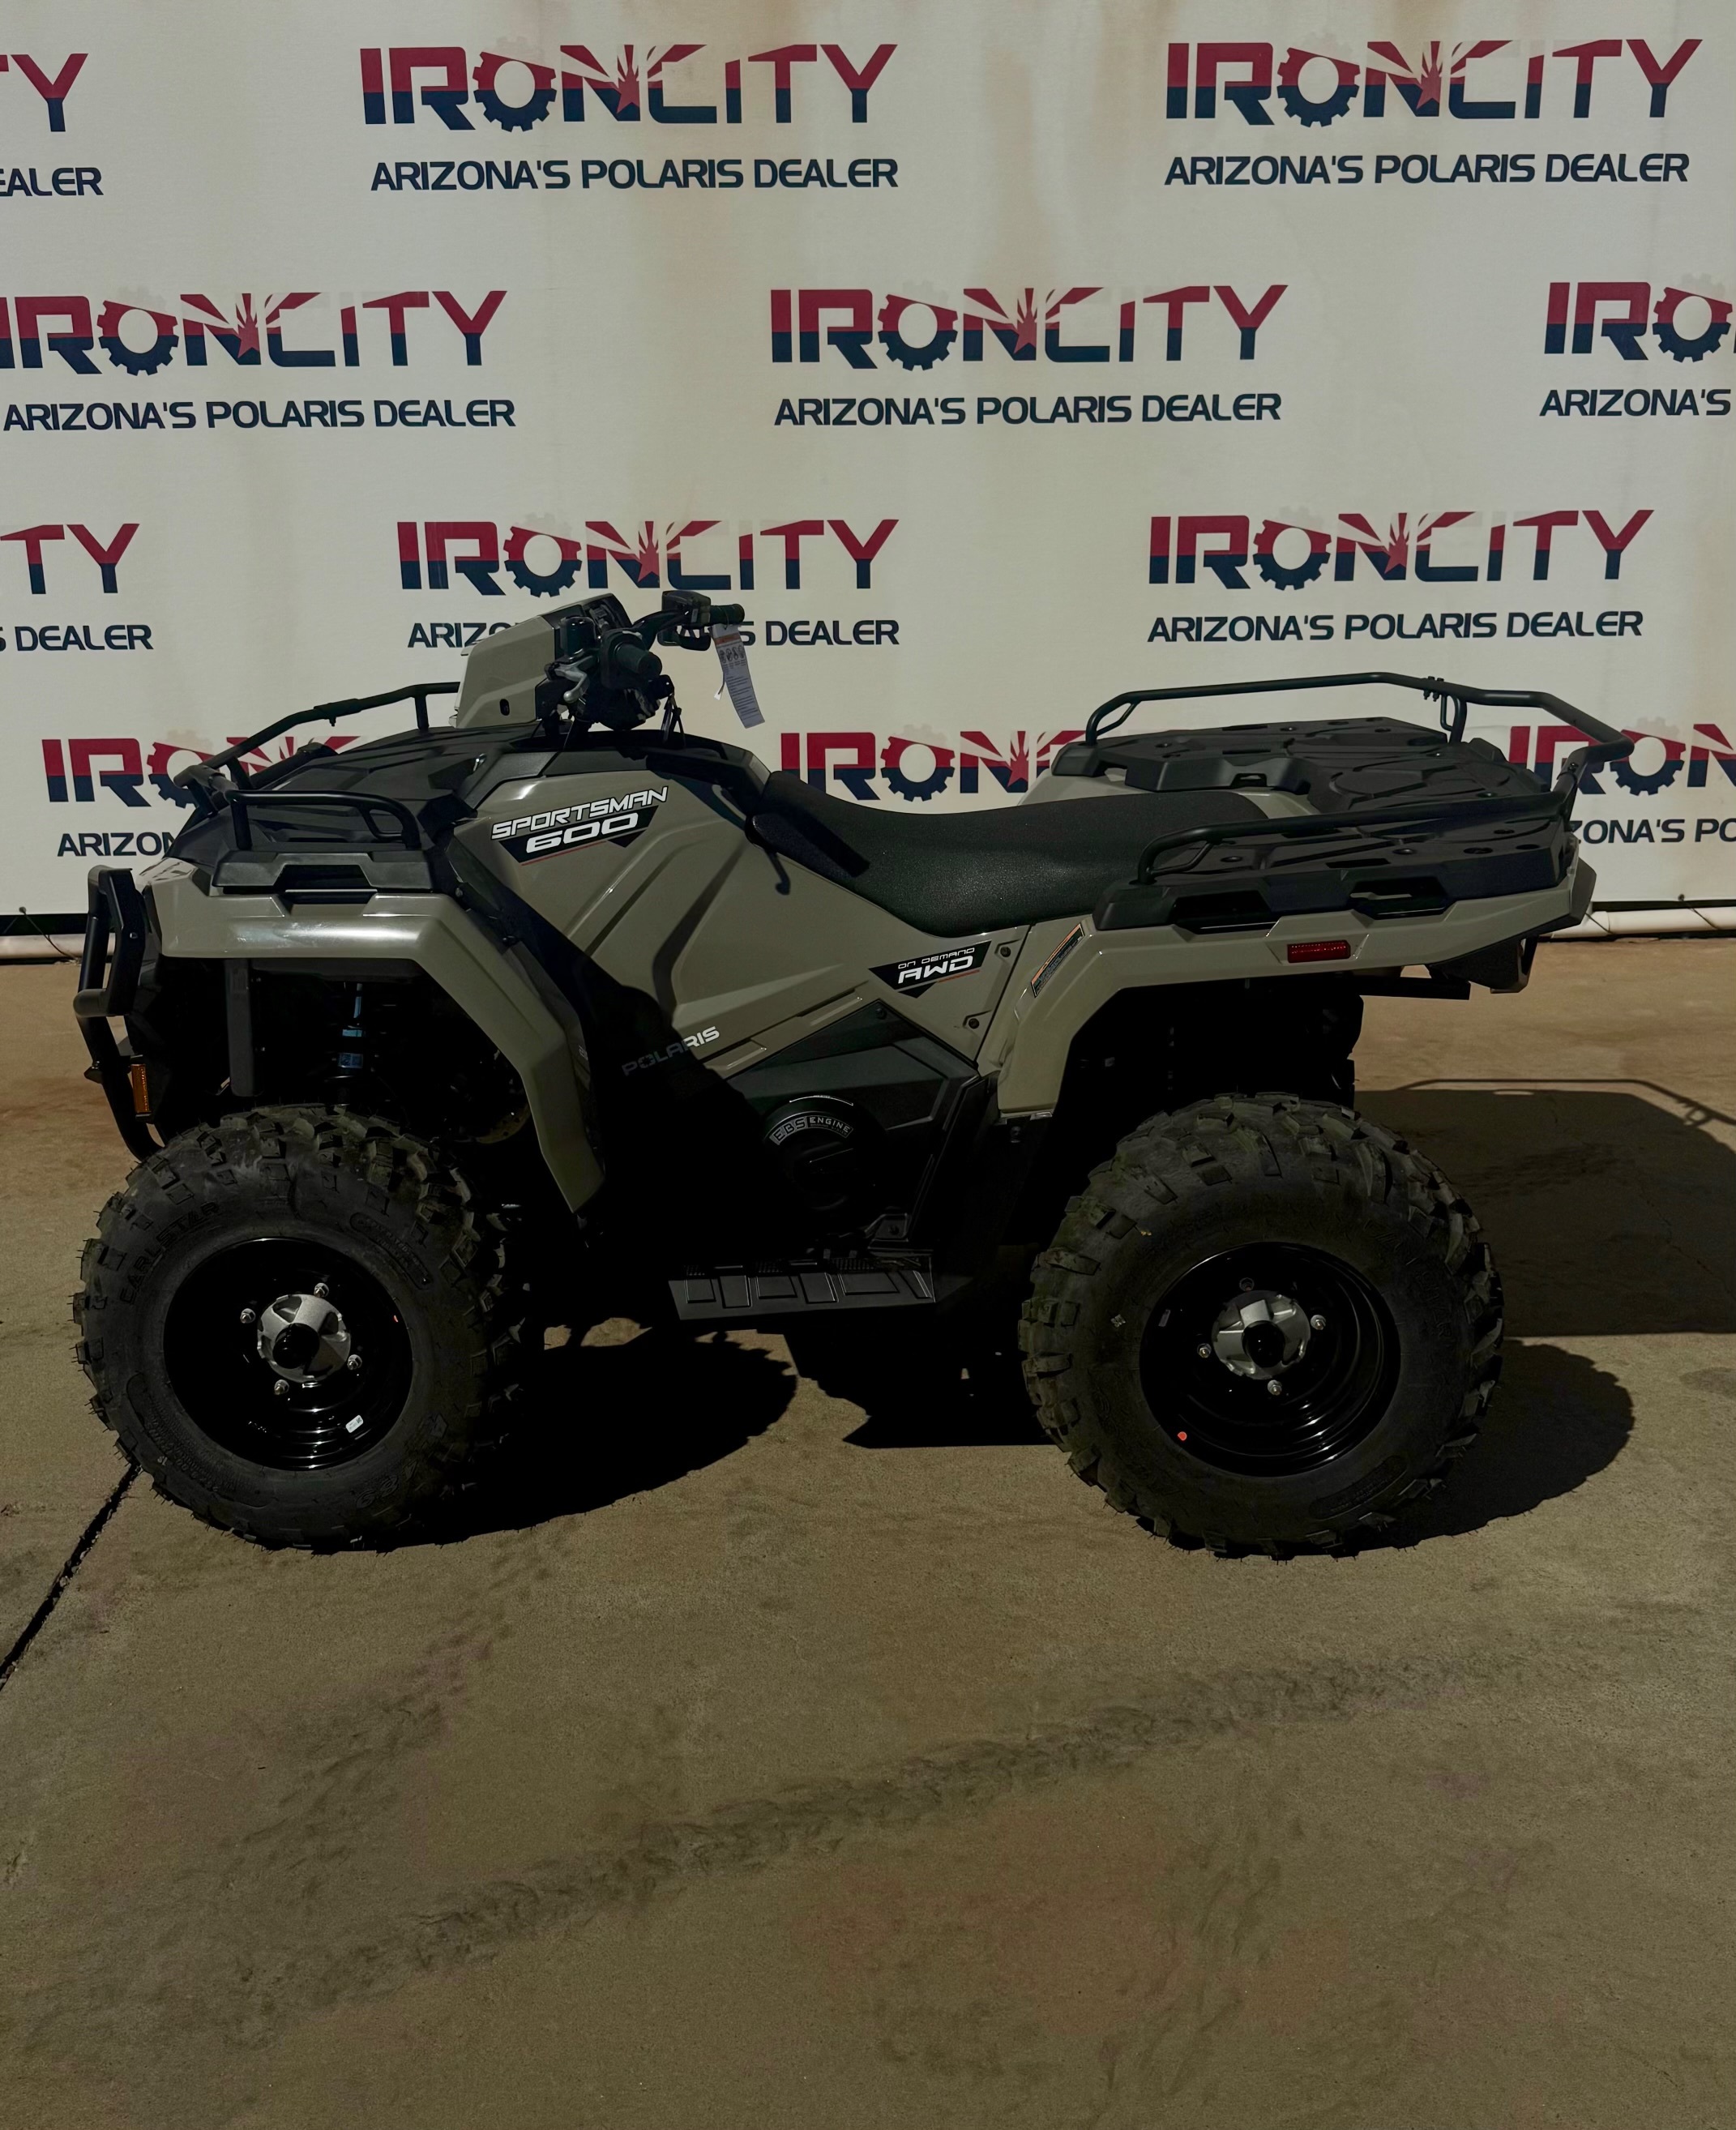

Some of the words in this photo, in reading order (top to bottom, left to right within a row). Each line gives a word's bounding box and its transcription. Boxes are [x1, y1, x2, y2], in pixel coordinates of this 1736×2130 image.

[361, 45, 897, 132] IRONCITY
[1166, 39, 1702, 127] IRONCITY
[371, 160, 570, 190] ARIZONA'S
[582, 160, 743, 189] POLARIS
[755, 159, 898, 187] DEALER
[1165, 156, 1363, 185] ARIZONA'S
[1375, 154, 1535, 183] POLARIS
[1546, 154, 1689, 182] DEALER
[771, 285, 1288, 370] IRONCITY
[1545, 282, 1736, 362] IRO
[3, 402, 196, 430] ARIZONA'S
[206, 400, 364, 428] POLARIS
[374, 400, 515, 426] DEALER
[775, 398, 965, 426] ARIZONA'S
[977, 396, 1131, 424] POLARIS
[1143, 394, 1281, 421] DEALER
[1540, 389, 1731, 416] ARIZONA'S
[397, 520, 899, 597] IRONCITY
[1149, 510, 1653, 590] IRONCITY
[15, 625, 153, 651] DEALER
[408, 622, 517, 648] ARIZ
[766, 620, 899, 645] DEALER
[1148, 615, 1333, 642] ARIZONA'S
[1345, 613, 1496, 639] POLARIS
[1507, 611, 1643, 637] DEALER
[491, 786, 669, 840] SPORTSMAN
[526, 812, 639, 853] 600
[897, 960, 917, 969] ON
[921, 947, 976, 964] DEMAND
[897, 955, 974, 985] AWD
[622, 1025, 720, 1076] POLARIS
[772, 1117, 806, 1143] EBS
[809, 1116, 851, 1133] ENGINE
